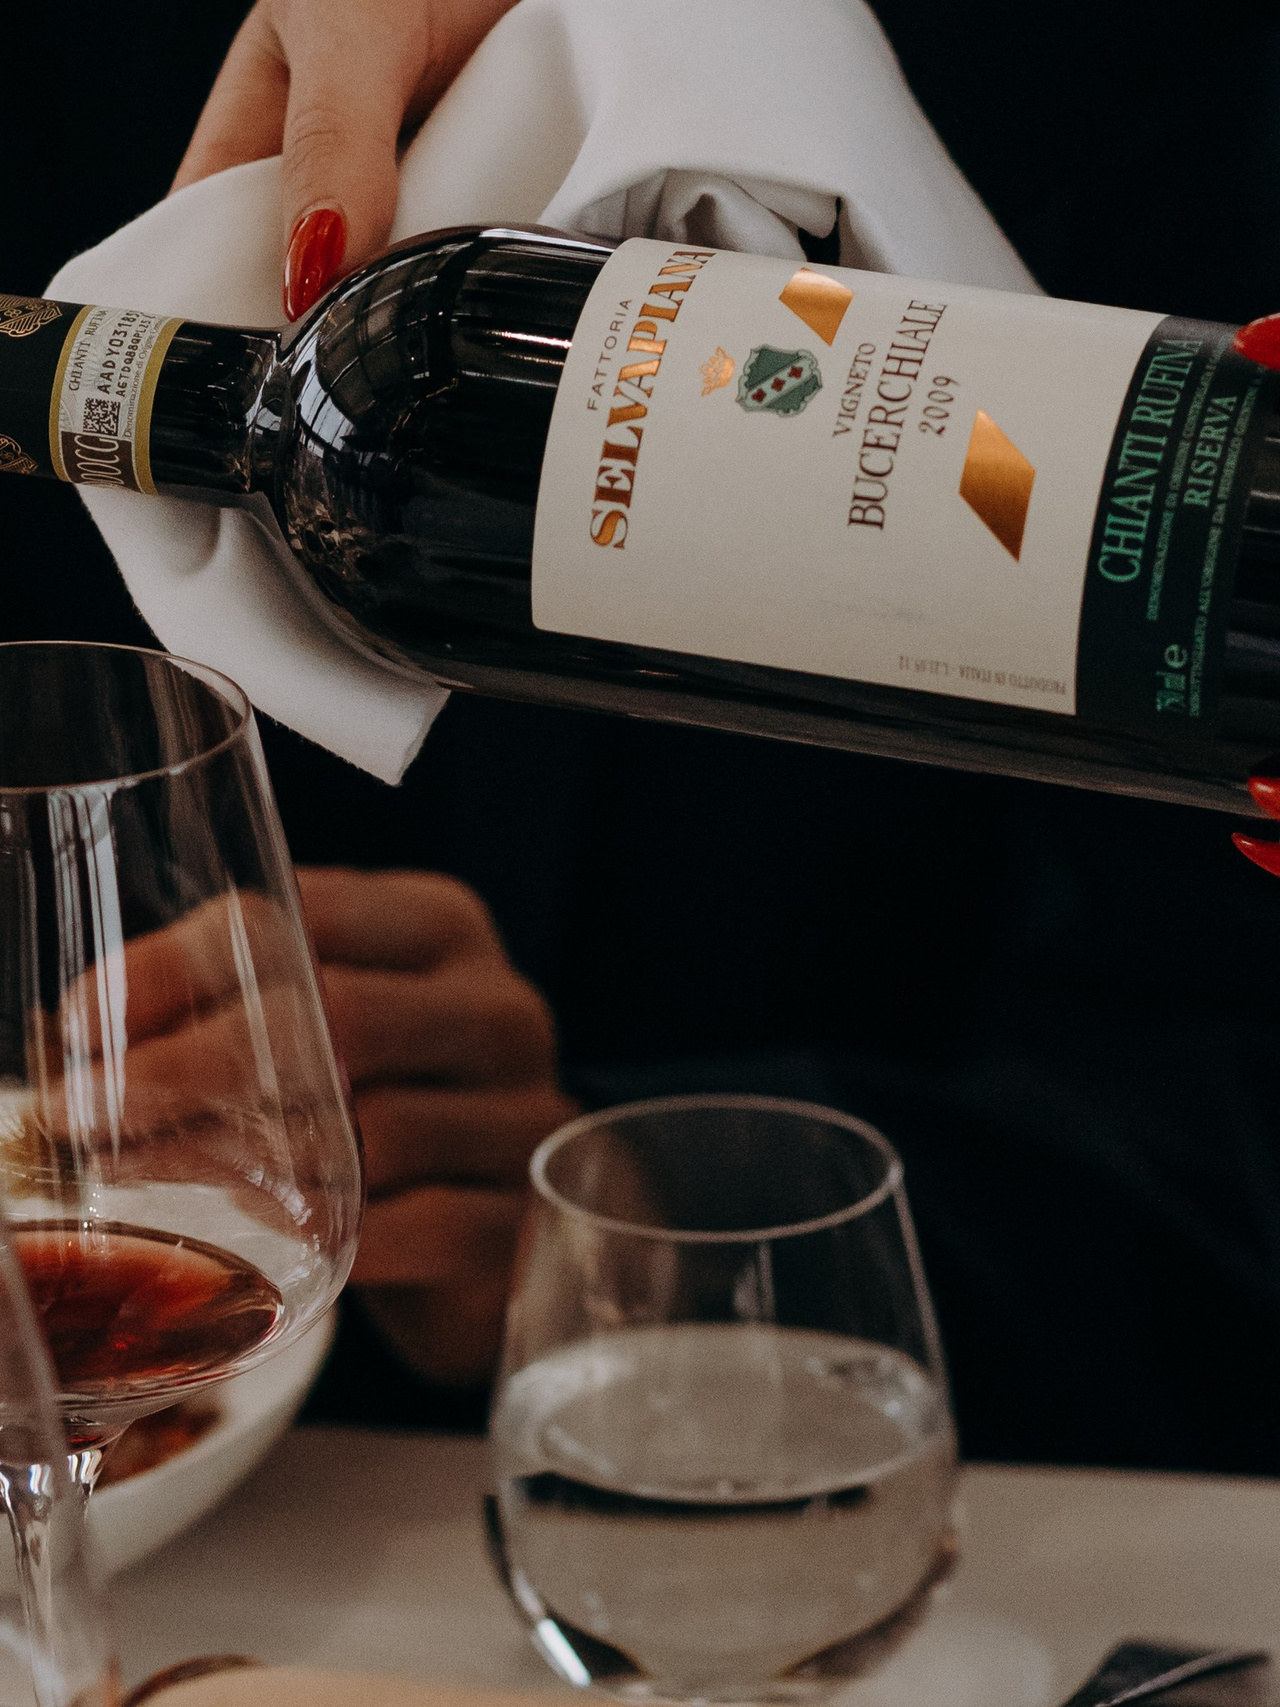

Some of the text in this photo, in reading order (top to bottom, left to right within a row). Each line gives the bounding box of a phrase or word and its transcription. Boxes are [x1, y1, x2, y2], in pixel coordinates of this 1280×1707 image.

[69, 310, 108, 392] CHIANTI RUFINA
[124, 369, 141, 438] Denominazione
[587, 298, 633, 411] FATTORIA
[589, 250, 717, 550] SELVAPIANA
[832, 342, 877, 438] VIGNETO
[918, 375, 961, 438] 2009
[847, 300, 948, 531] BUCERCHIALE
[1098, 338, 1203, 583] CHIANTI RUFINA
[1182, 395, 1238, 508] RISERVA
